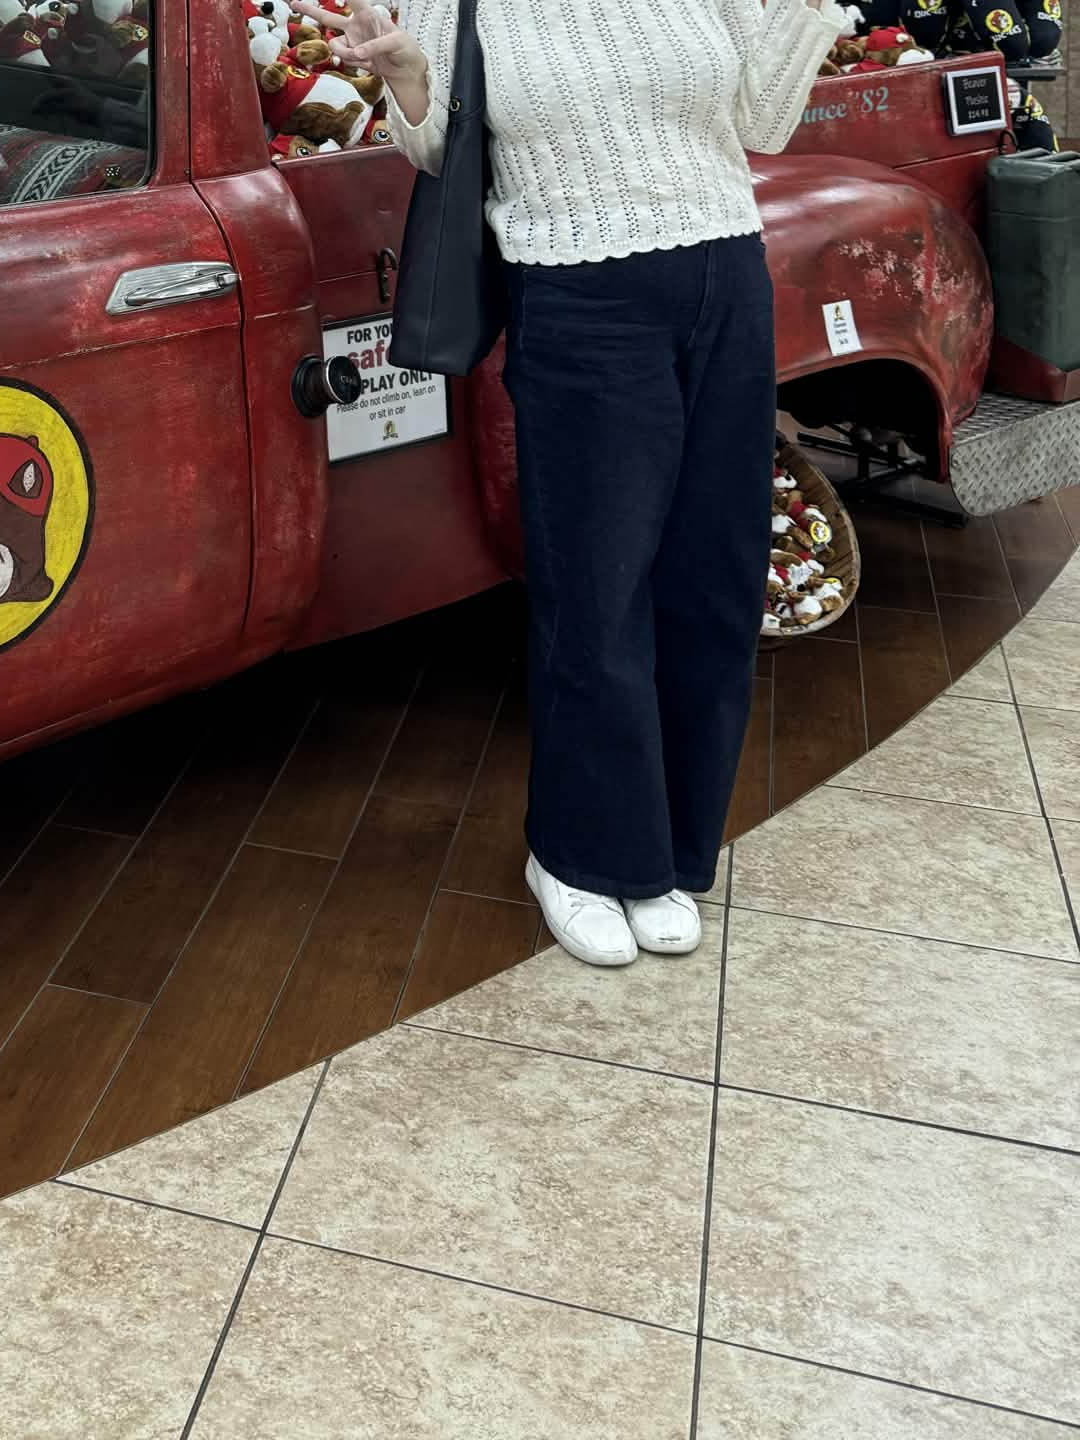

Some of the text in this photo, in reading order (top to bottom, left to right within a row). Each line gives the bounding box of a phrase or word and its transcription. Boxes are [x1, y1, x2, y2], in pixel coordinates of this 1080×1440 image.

[802, 86, 889, 124] ince '82
[346, 328, 372, 345] FOR
[360, 373, 396, 395] PLAY
[336, 402, 359, 415] Please
[359, 399, 369, 409] do
[370, 395, 381, 407] not
[382, 390, 401, 405] climb
[427, 384, 437, 395] on
[378, 407, 387, 419] sit
[387, 406, 395, 417] in
[395, 405, 407, 415] car
